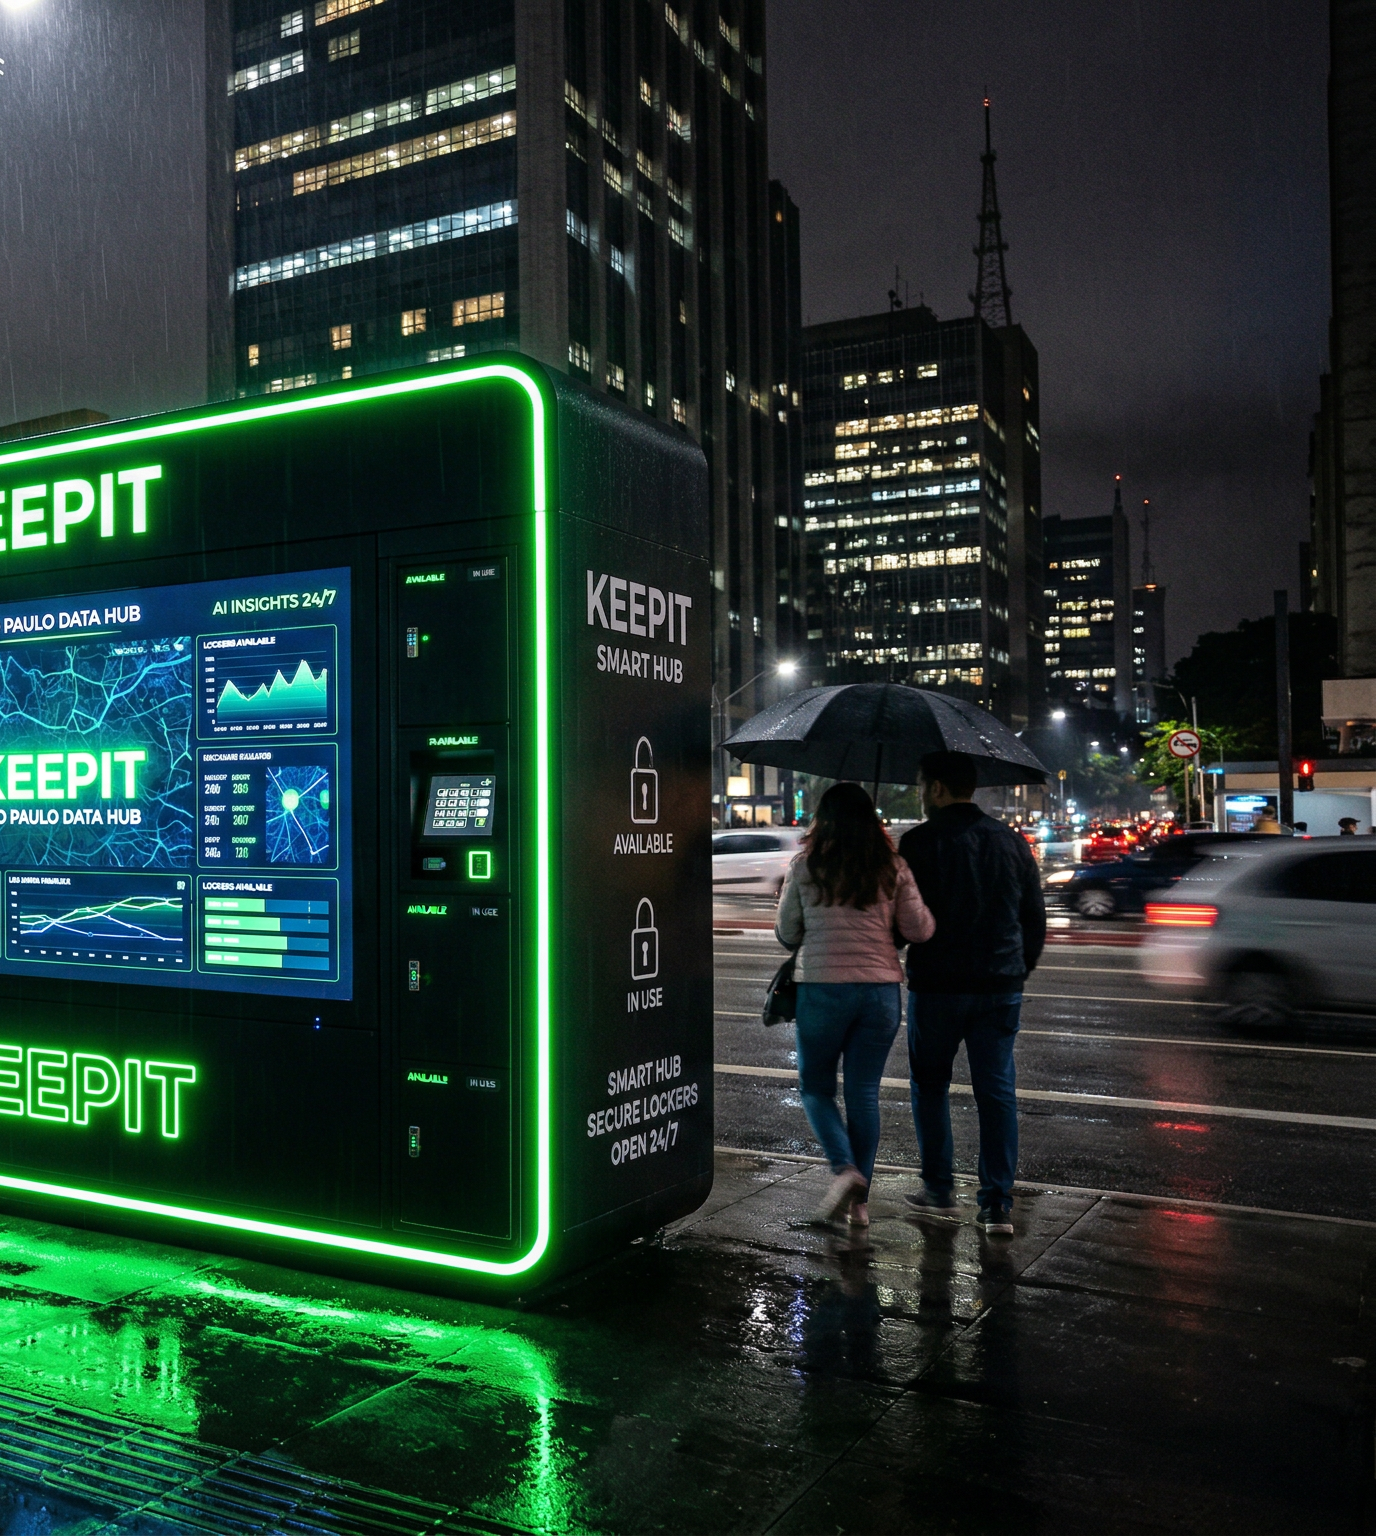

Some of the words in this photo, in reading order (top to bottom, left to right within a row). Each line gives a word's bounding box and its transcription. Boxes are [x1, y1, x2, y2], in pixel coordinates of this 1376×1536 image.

[3, 613, 55, 634] PAULO
[58, 609, 102, 629] DATA
[104, 604, 142, 625] HUB
[212, 601, 228, 616] AI
[231, 593, 299, 614] INSIGHTS
[302, 588, 337, 608] 24/7
[586, 569, 692, 646] KEEPIT
[596, 644, 650, 679] SMART
[653, 654, 684, 684] HUB
[10, 809, 60, 825] PAULO
[62, 809, 104, 825] DATA
[107, 808, 142, 825] HUB
[613, 832, 674, 855] AVAILABLE
[627, 990, 640, 1013] IN
[641, 987, 664, 1010] USE
[607, 1061, 654, 1097] SMART
[655, 1054, 682, 1083] HUB
[586, 1099, 642, 1138] SECURE
[643, 1082, 699, 1121] LOCKERS
[610, 1133, 647, 1166] OPEN
[649, 1119, 679, 1155] 24/7
